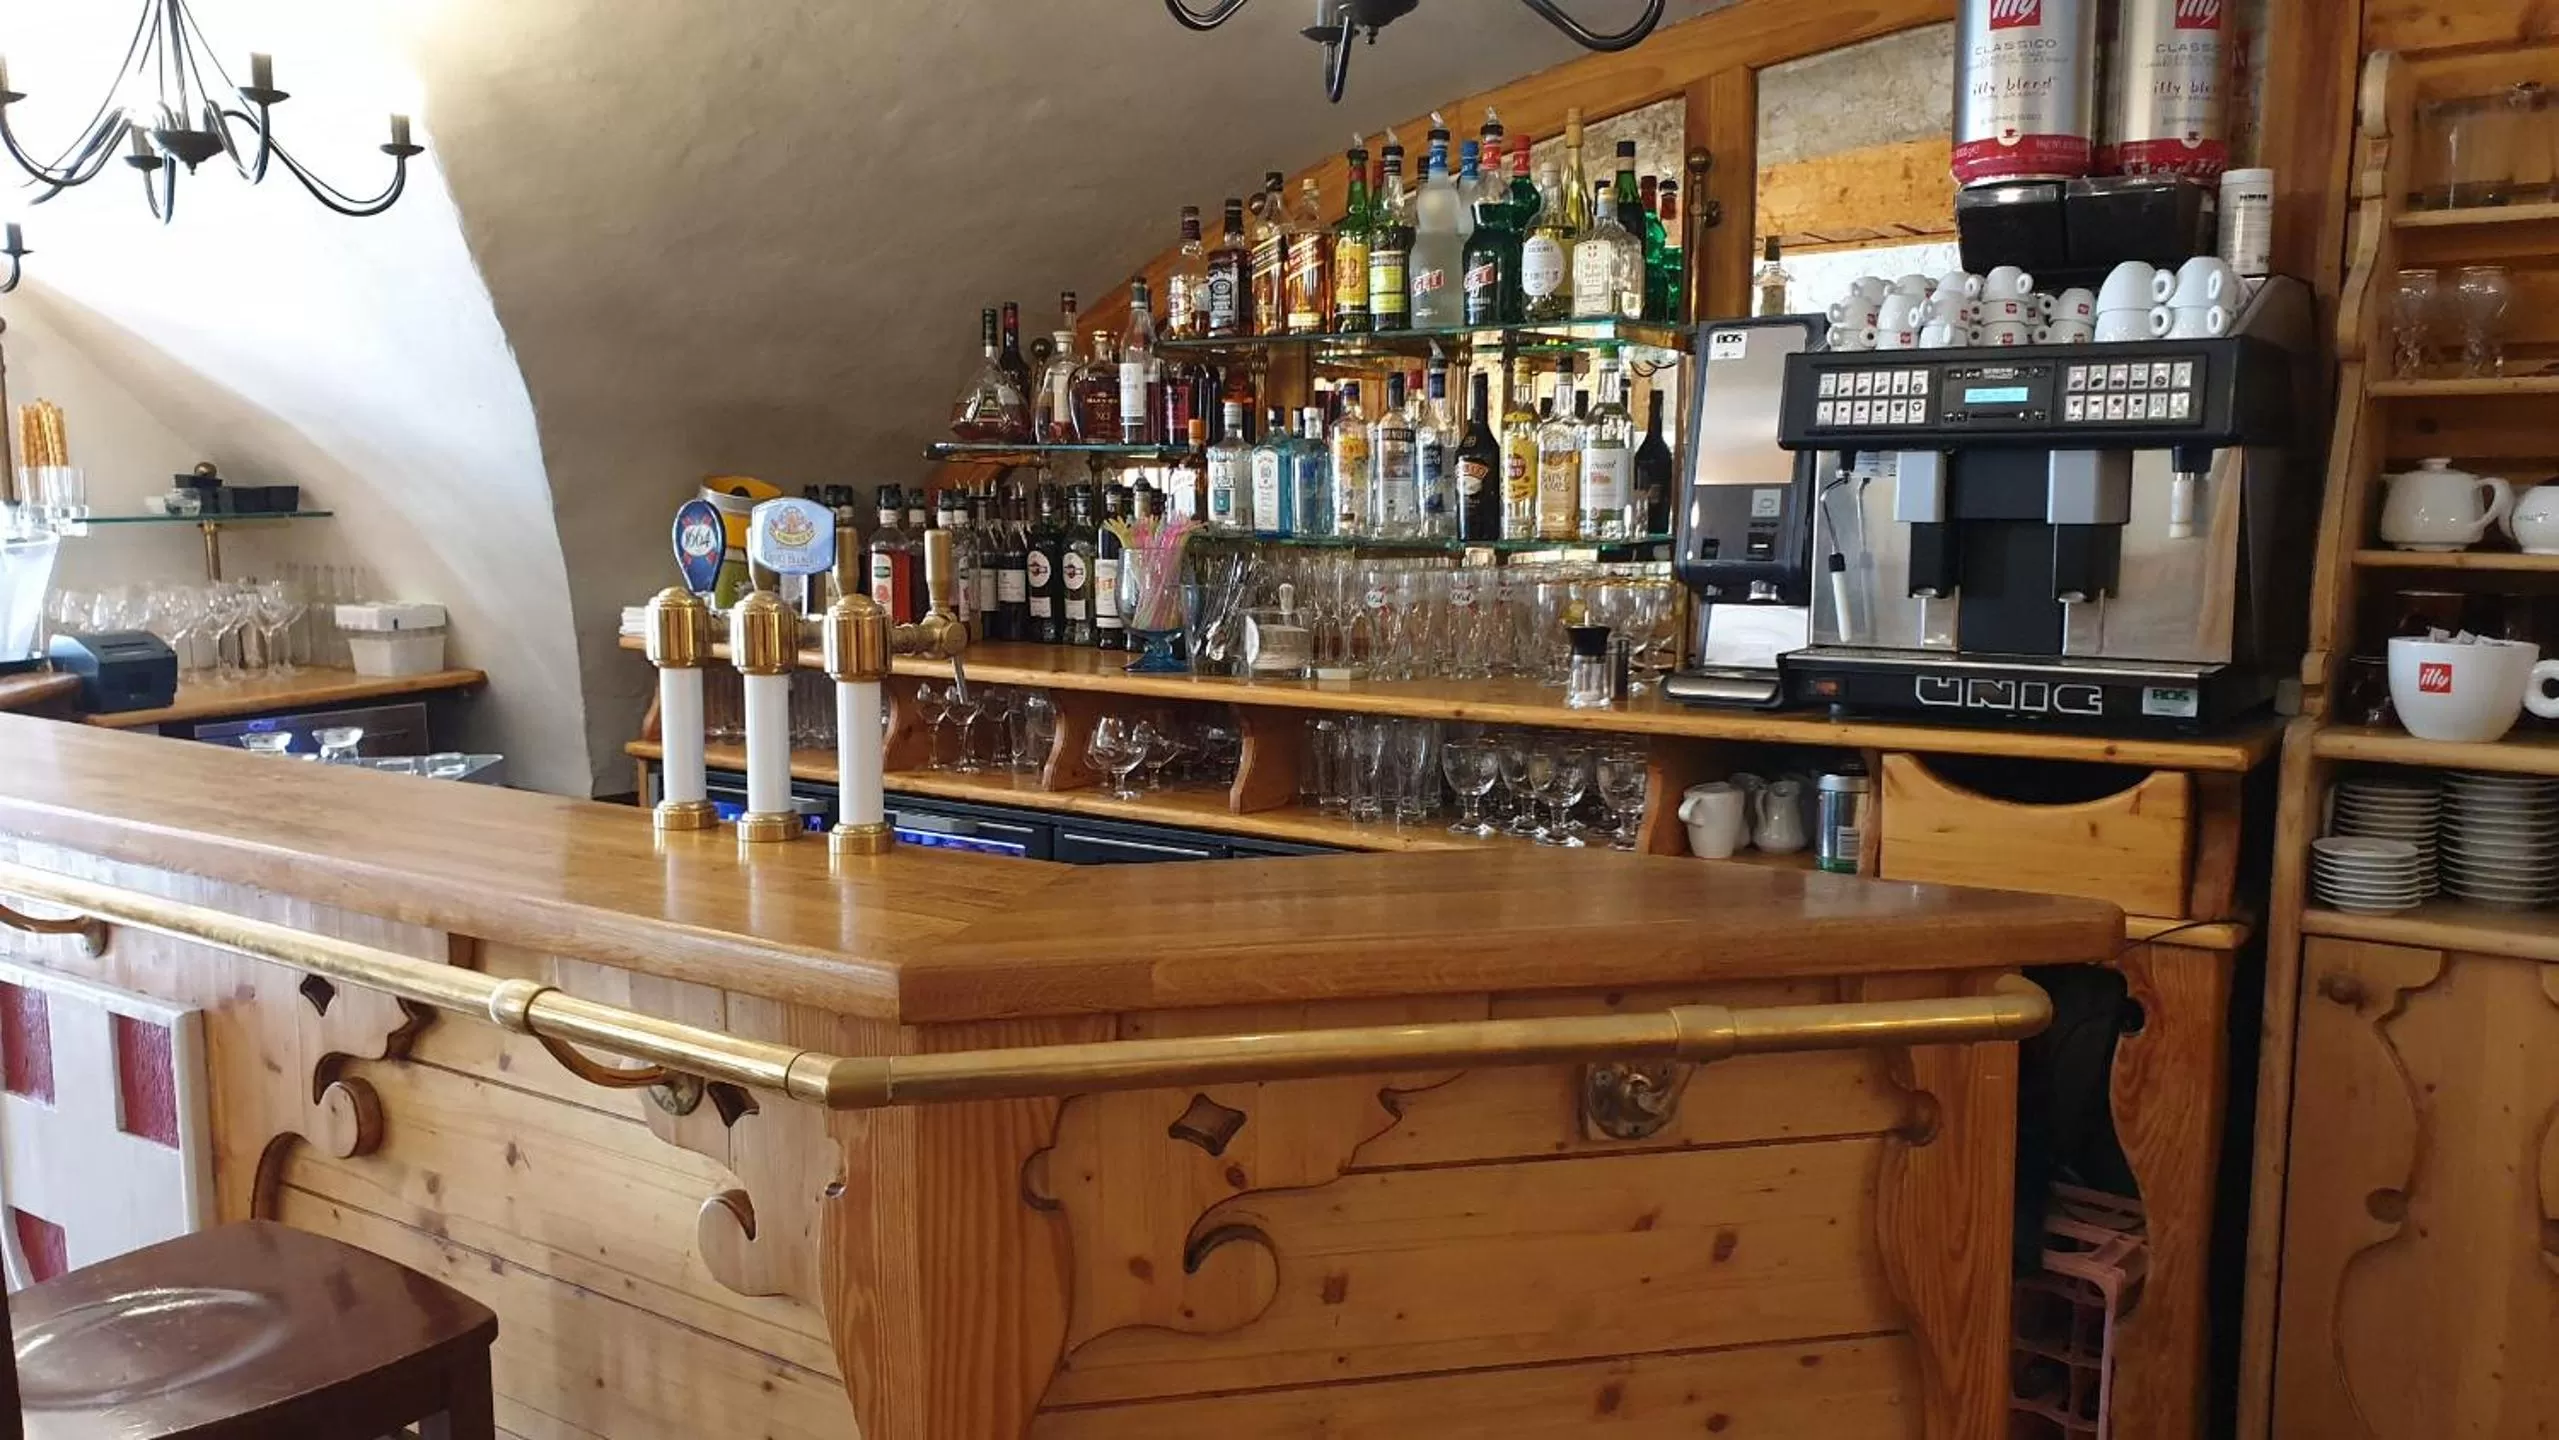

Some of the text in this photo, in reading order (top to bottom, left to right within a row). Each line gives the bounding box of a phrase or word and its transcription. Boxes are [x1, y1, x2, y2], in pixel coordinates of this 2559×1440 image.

[1992, 0, 2036, 24] illy
[2178, 0, 2221, 26] illy
[1974, 38, 2058, 56] CLASSICO
[2006, 76, 2053, 92] blend
[2420, 667, 2449, 691] illy
[1915, 675, 2103, 715] UNIC
